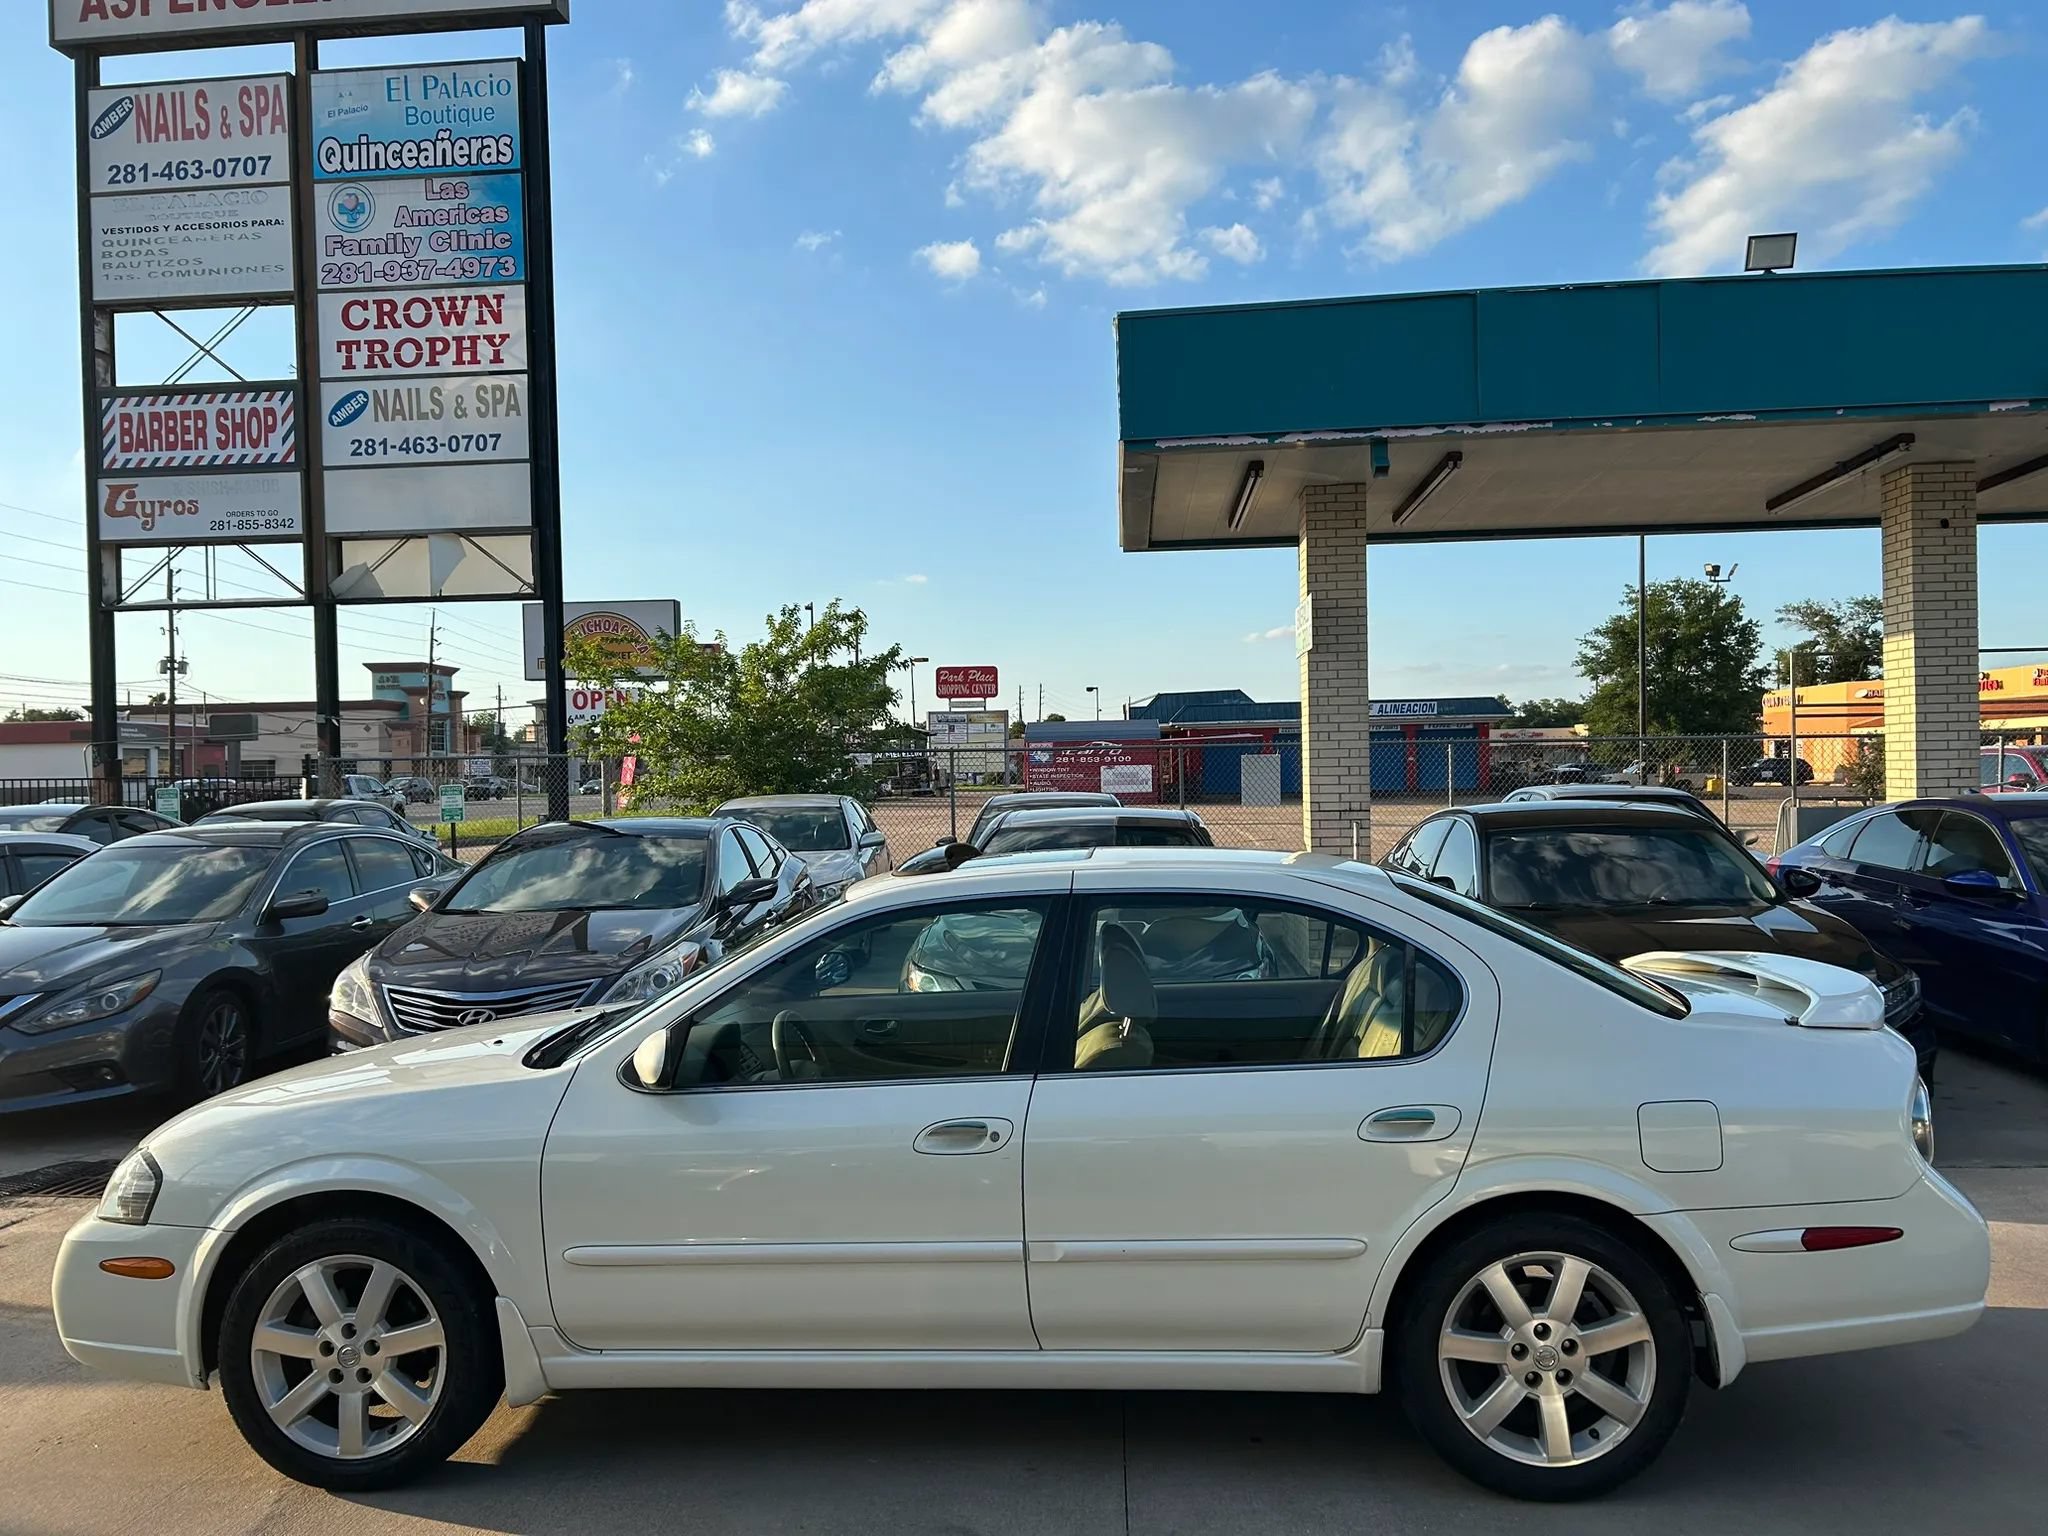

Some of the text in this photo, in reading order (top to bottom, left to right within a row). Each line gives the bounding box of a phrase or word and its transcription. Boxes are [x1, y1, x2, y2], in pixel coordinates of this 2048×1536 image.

[94, 84, 288, 144] AMBER NAILS & SPA
[405, 104, 496, 127] Boutique
[318, 128, 514, 174] Quinceañeras
[107, 155, 272, 185] 281-463-0707
[424, 178, 469, 201] Las
[102, 218, 285, 236] VESTIDOS Y ACCESORIOS PARA:
[394, 203, 509, 228] Americas
[101, 247, 170, 259] BODAS
[325, 228, 513, 258] Family Clinic
[102, 257, 204, 270] BAUTIZOS
[147, 264, 286, 280] COMUNIONES
[321, 255, 516, 285] 281-937-4973
[341, 293, 506, 331] CROWN
[336, 333, 511, 371] TROPHY
[331, 383, 522, 426] AMBER NAILS & SPA
[119, 406, 278, 453] BARBER SHOP
[349, 433, 502, 457] 281-463-0707
[104, 483, 200, 532] Gyros
[225, 509, 279, 518] ORDERS TO GO
[209, 517, 295, 531] 281-855-8342
[939, 669, 995, 683] Park Place
[938, 683, 997, 696] SHOPPING CENTER
[1377, 703, 1436, 715] ALINEACION
